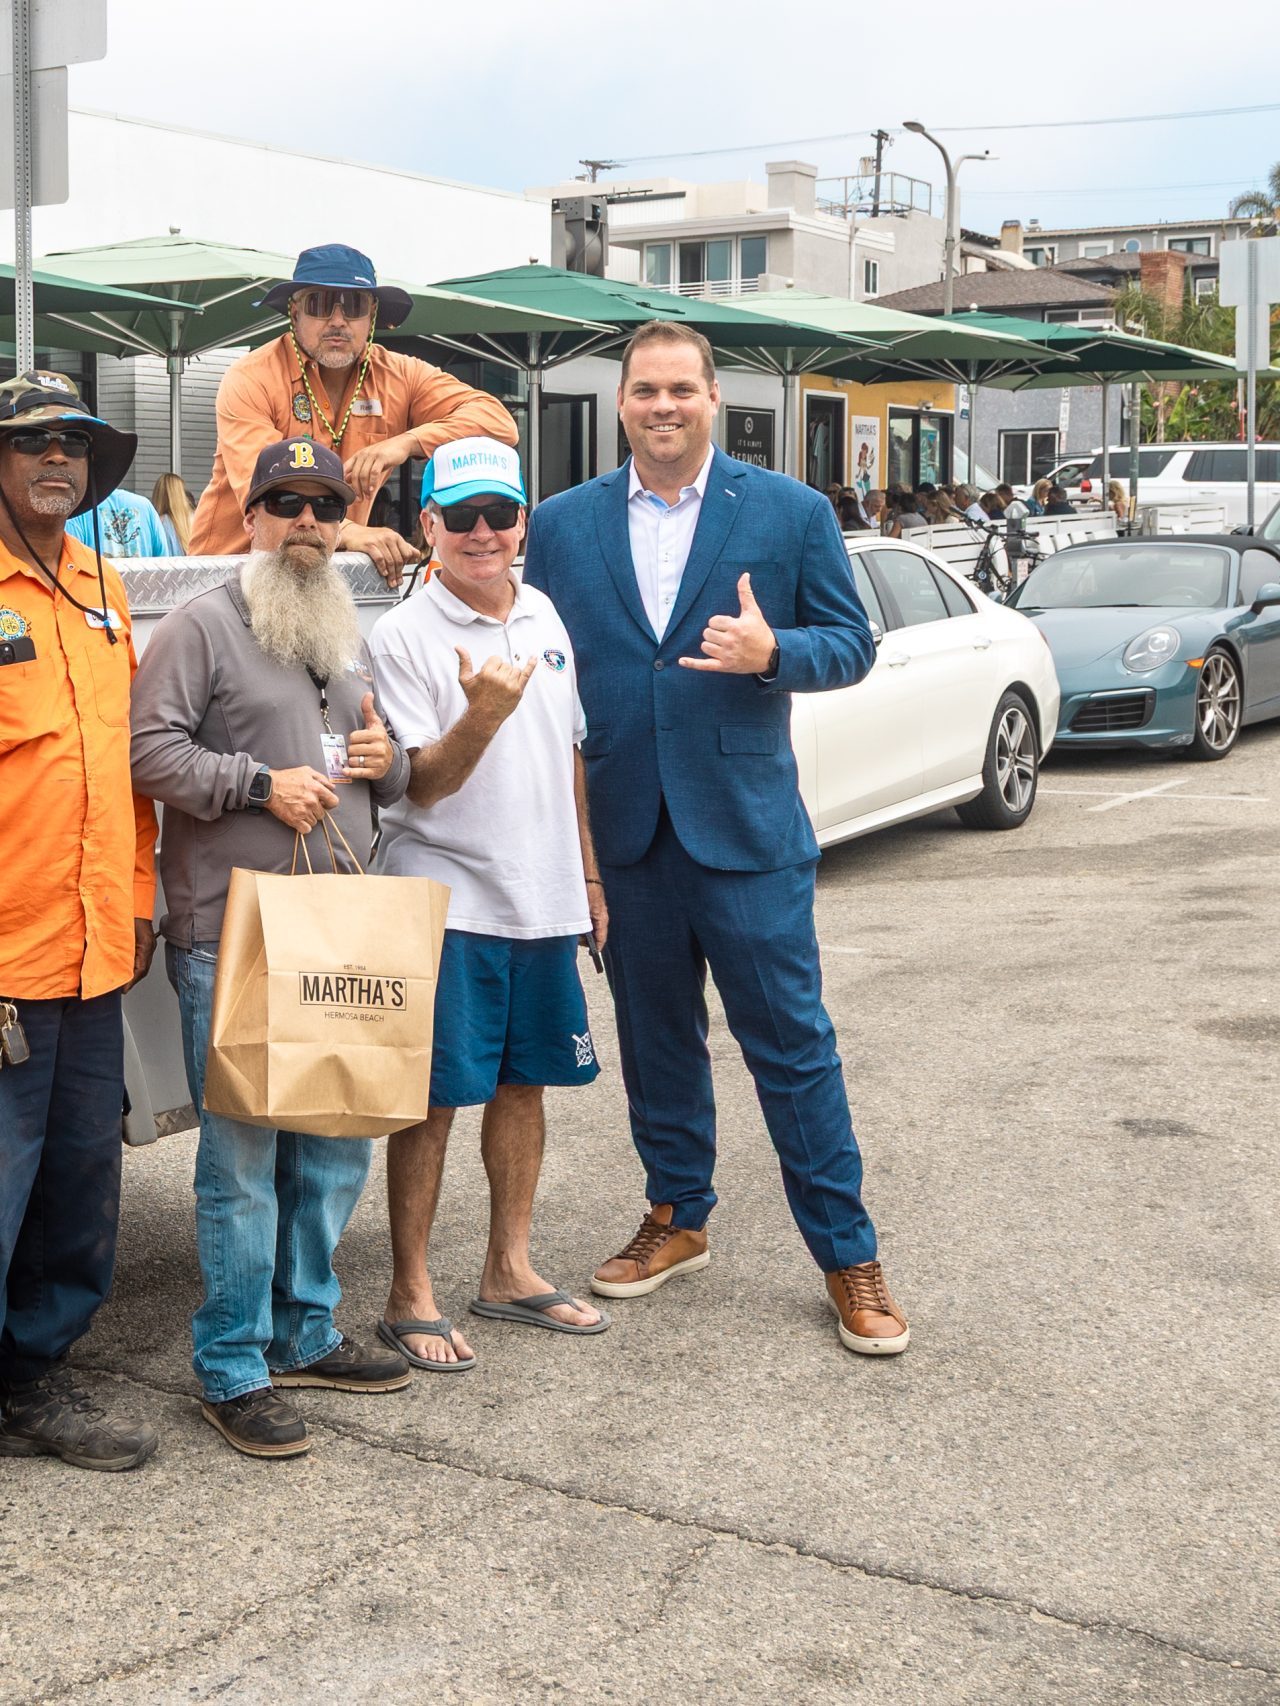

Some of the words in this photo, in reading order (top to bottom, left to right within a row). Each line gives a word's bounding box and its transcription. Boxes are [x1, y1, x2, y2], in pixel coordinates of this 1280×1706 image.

[289, 443, 315, 469] B
[452, 452, 508, 471] MARTHA'S
[303, 975, 404, 1007] MARTHA'S
[324, 1011, 358, 1021] HERMOSA
[360, 1014, 385, 1023] BEACH
